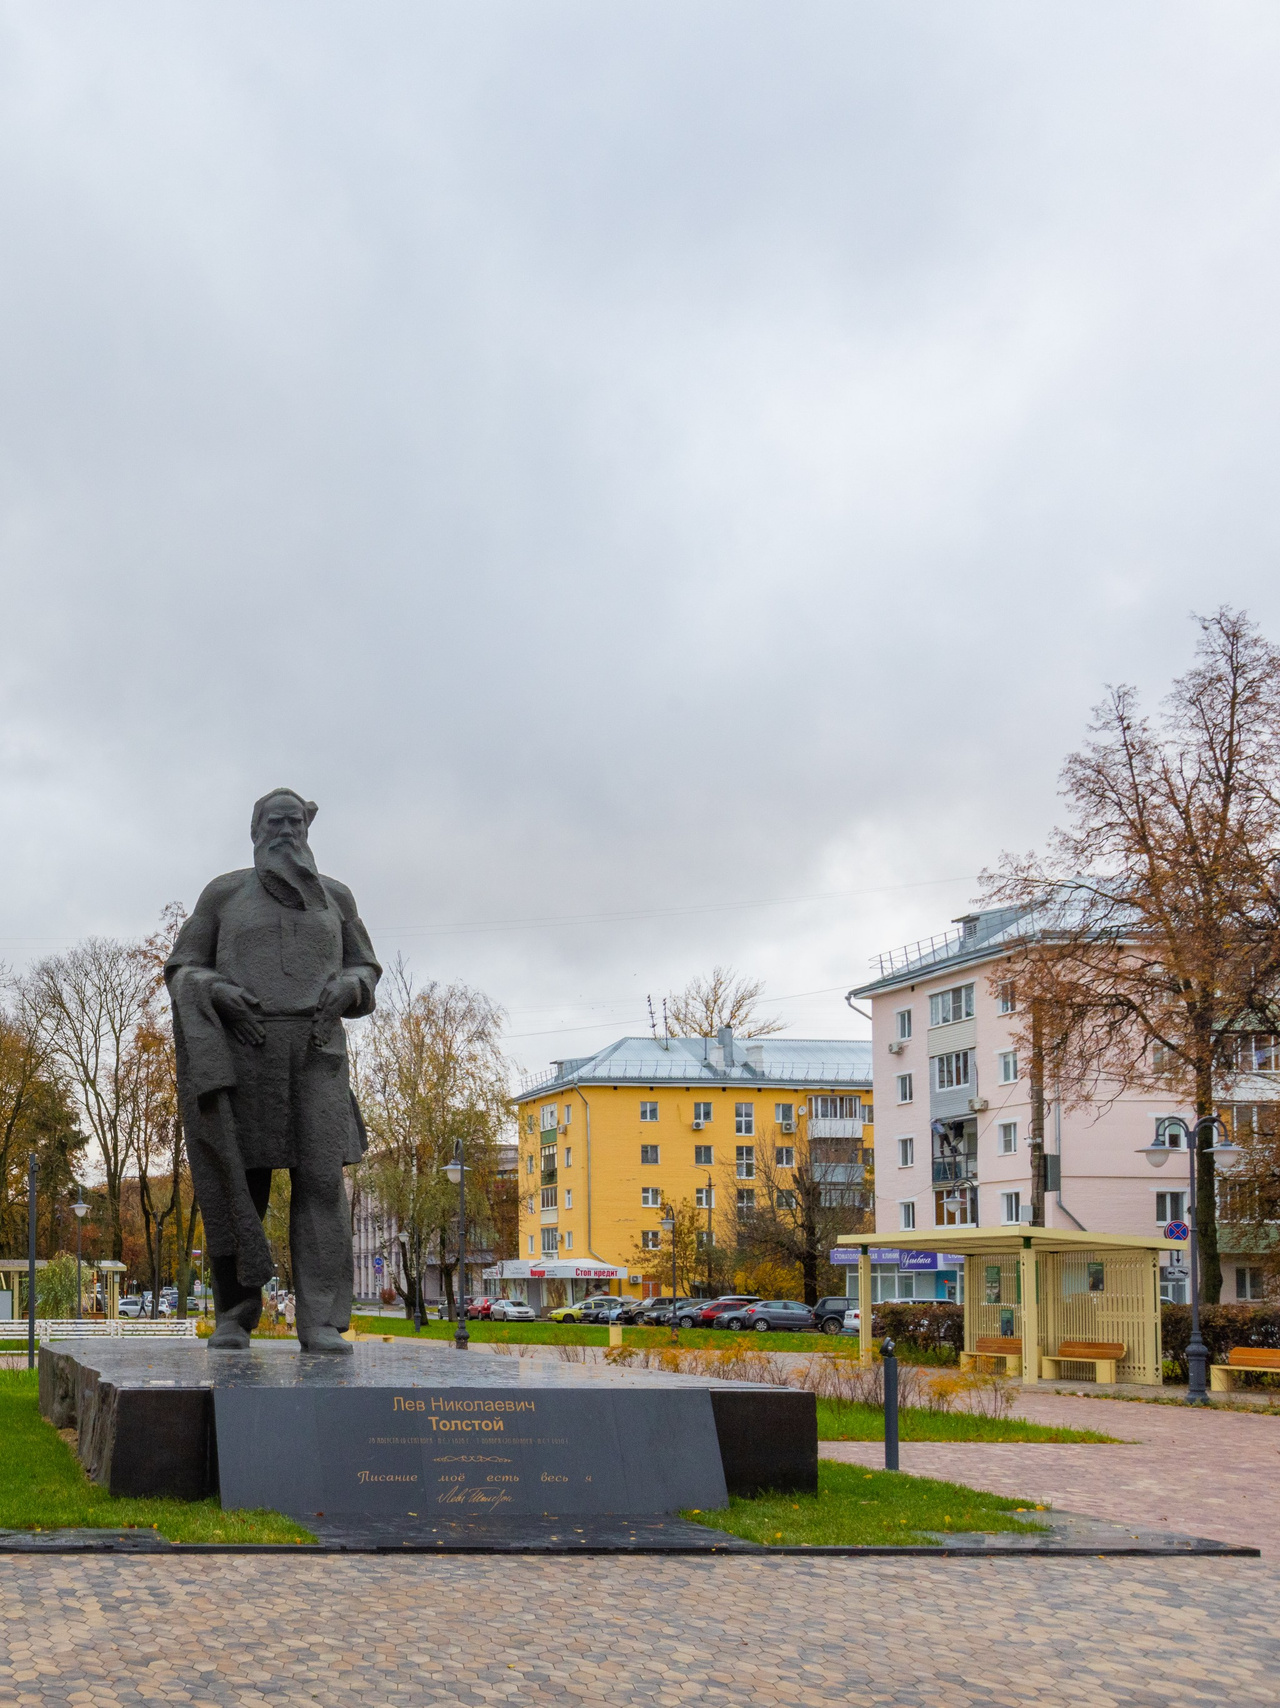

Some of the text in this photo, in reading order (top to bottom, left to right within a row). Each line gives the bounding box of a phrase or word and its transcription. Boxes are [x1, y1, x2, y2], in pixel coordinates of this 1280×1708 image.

[575, 1268, 618, 1278] Стоп кредит
[393, 1396, 535, 1412] Лев Николаевич
[427, 1416, 504, 1431] Толстой
[357, 1470, 592, 1484] Писание моё есть весь я
